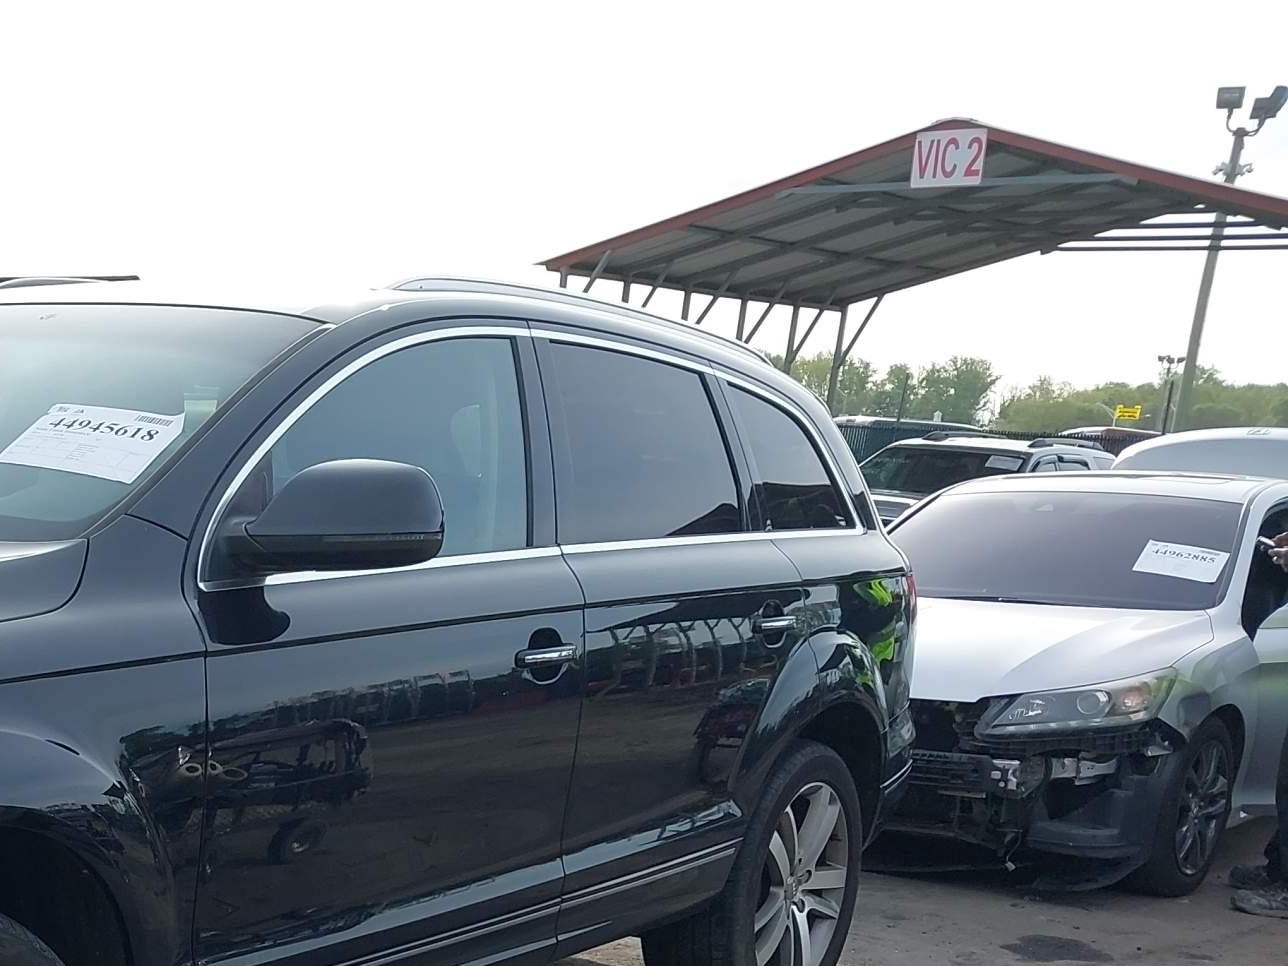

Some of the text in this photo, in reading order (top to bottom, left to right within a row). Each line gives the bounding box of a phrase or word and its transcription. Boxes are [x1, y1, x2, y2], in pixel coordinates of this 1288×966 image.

[917, 136, 983, 179] VIC 2
[49, 417, 160, 442] 44945618
[1152, 547, 1216, 564] 44962885
